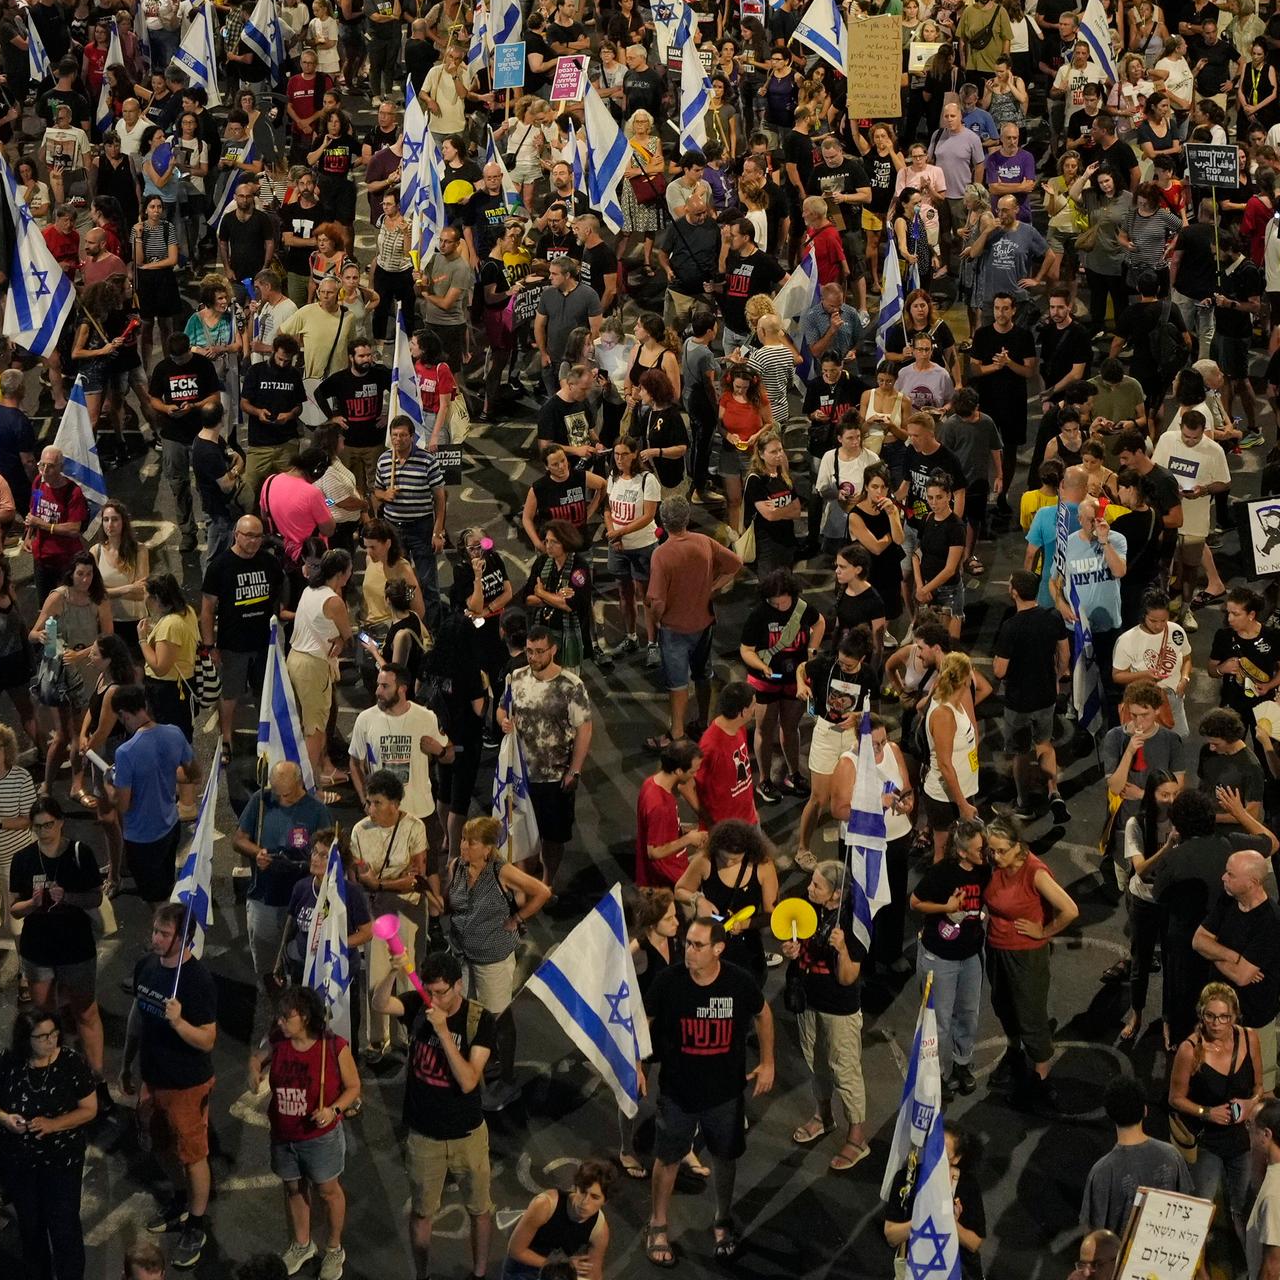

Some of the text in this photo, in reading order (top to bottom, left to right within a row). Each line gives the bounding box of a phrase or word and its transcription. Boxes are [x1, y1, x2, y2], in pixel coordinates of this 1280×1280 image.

[1205, 167, 1222, 175] STOP
[169, 377, 199, 391] FCK
[237, 570, 267, 587] בוחרים
[680, 1017, 733, 1048] עכשיו
[275, 1087, 308, 1103] אתה
[278, 1101, 308, 1117] אשם
